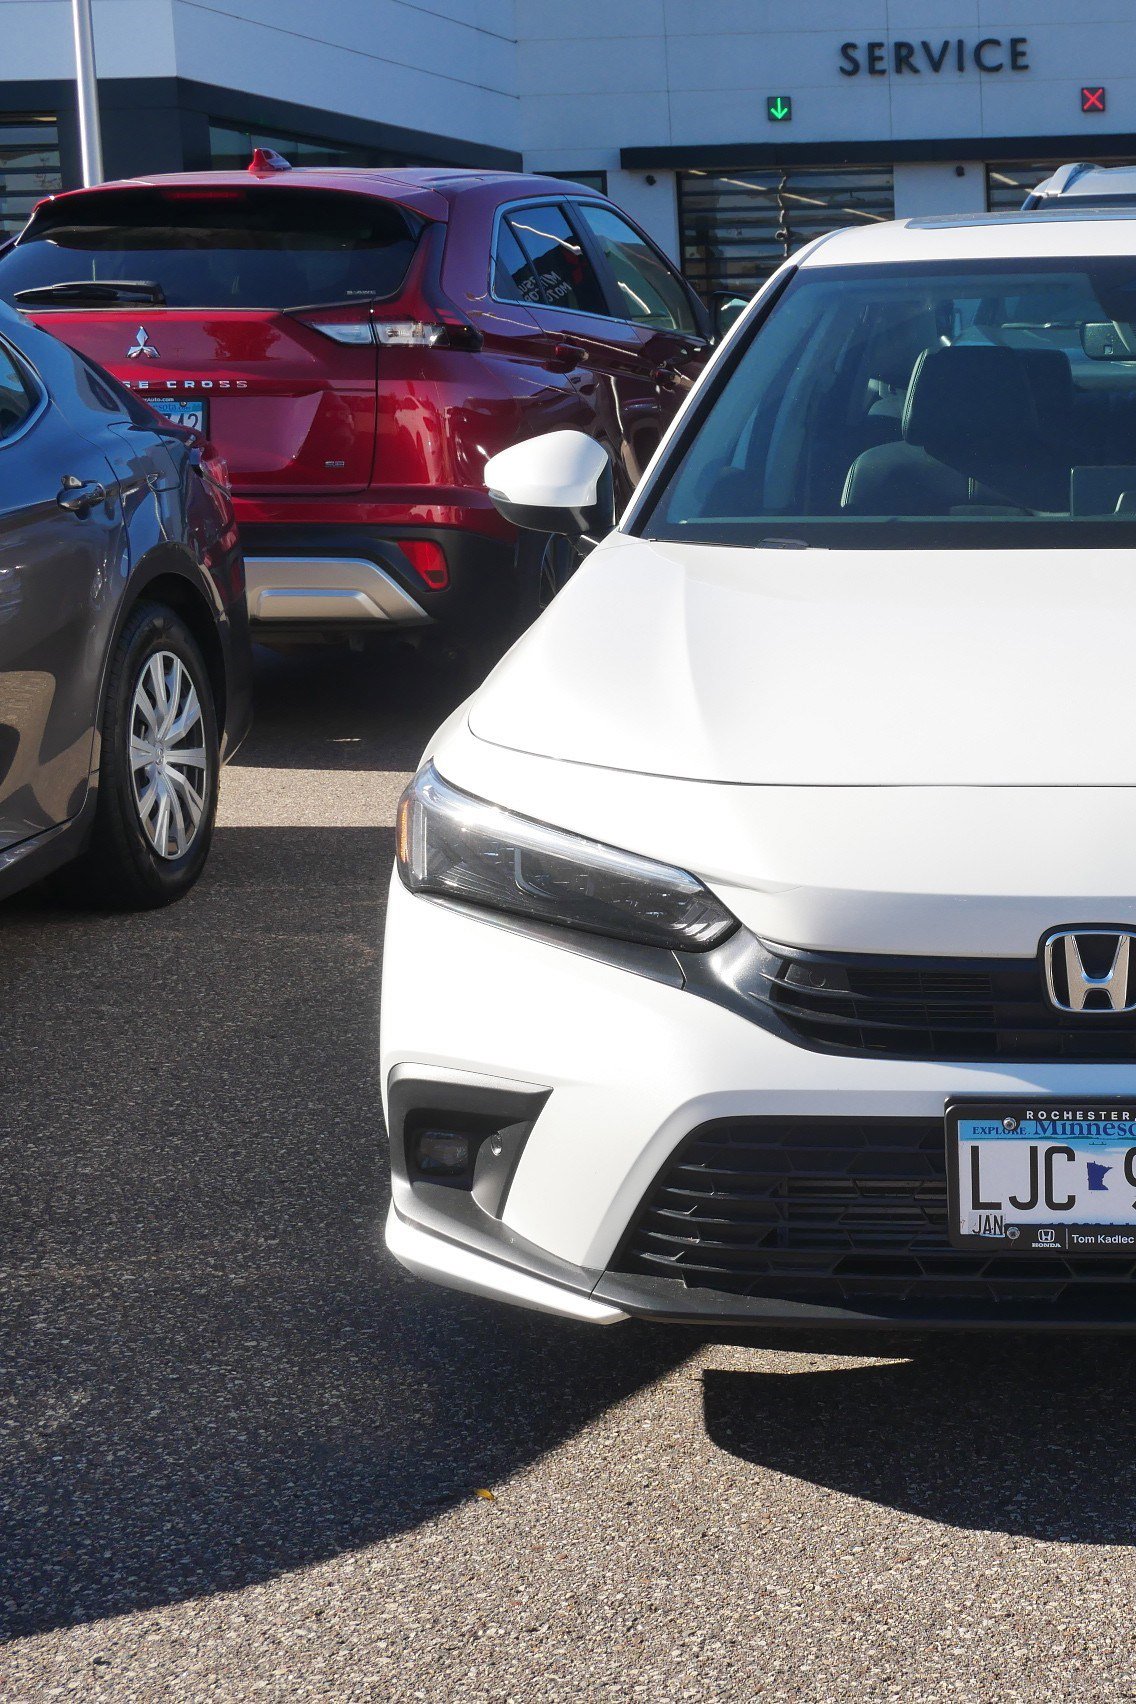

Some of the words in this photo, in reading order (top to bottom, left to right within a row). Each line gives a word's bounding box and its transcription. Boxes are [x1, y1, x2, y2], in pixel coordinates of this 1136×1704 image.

[839, 37, 1030, 78] SERVICE
[166, 380, 248, 389] CROSS
[970, 1145, 1076, 1211] LJC
[972, 1214, 1004, 1235] JAN
[1071, 1234, 1095, 1244] Tom
[1097, 1234, 1135, 1244] Kadlec
